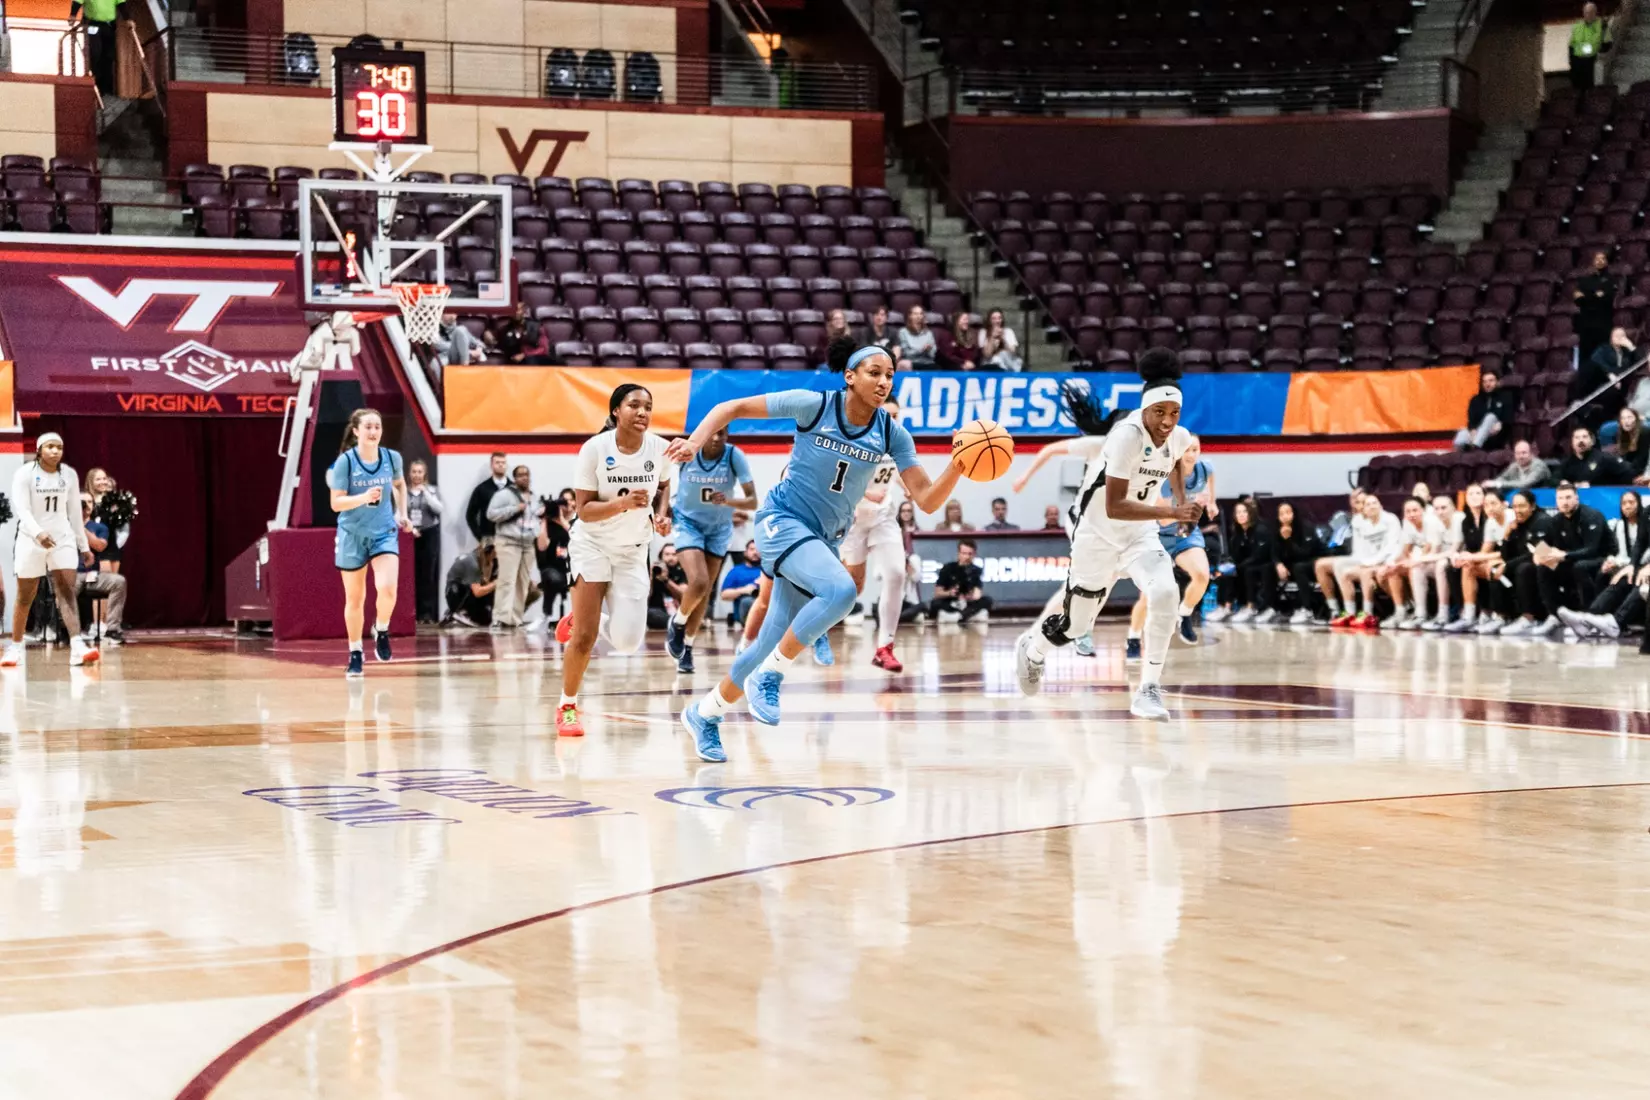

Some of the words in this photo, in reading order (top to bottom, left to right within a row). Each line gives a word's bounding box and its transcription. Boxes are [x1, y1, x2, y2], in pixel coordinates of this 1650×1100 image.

[363, 64, 412, 91] 7:40
[357, 92, 406, 136] 30
[496, 127, 590, 177] VT
[50, 275, 284, 333] VT
[91, 357, 177, 372] FIRST
[117, 394, 223, 412] VIRGINIA
[896, 376, 1091, 428] ADNESS
[815, 436, 882, 463] COLUMBIA
[607, 475, 654, 483] VANDERBILT
[829, 459, 850, 493] 1
[874, 467, 895, 484] 35
[45, 496, 58, 512] 11
